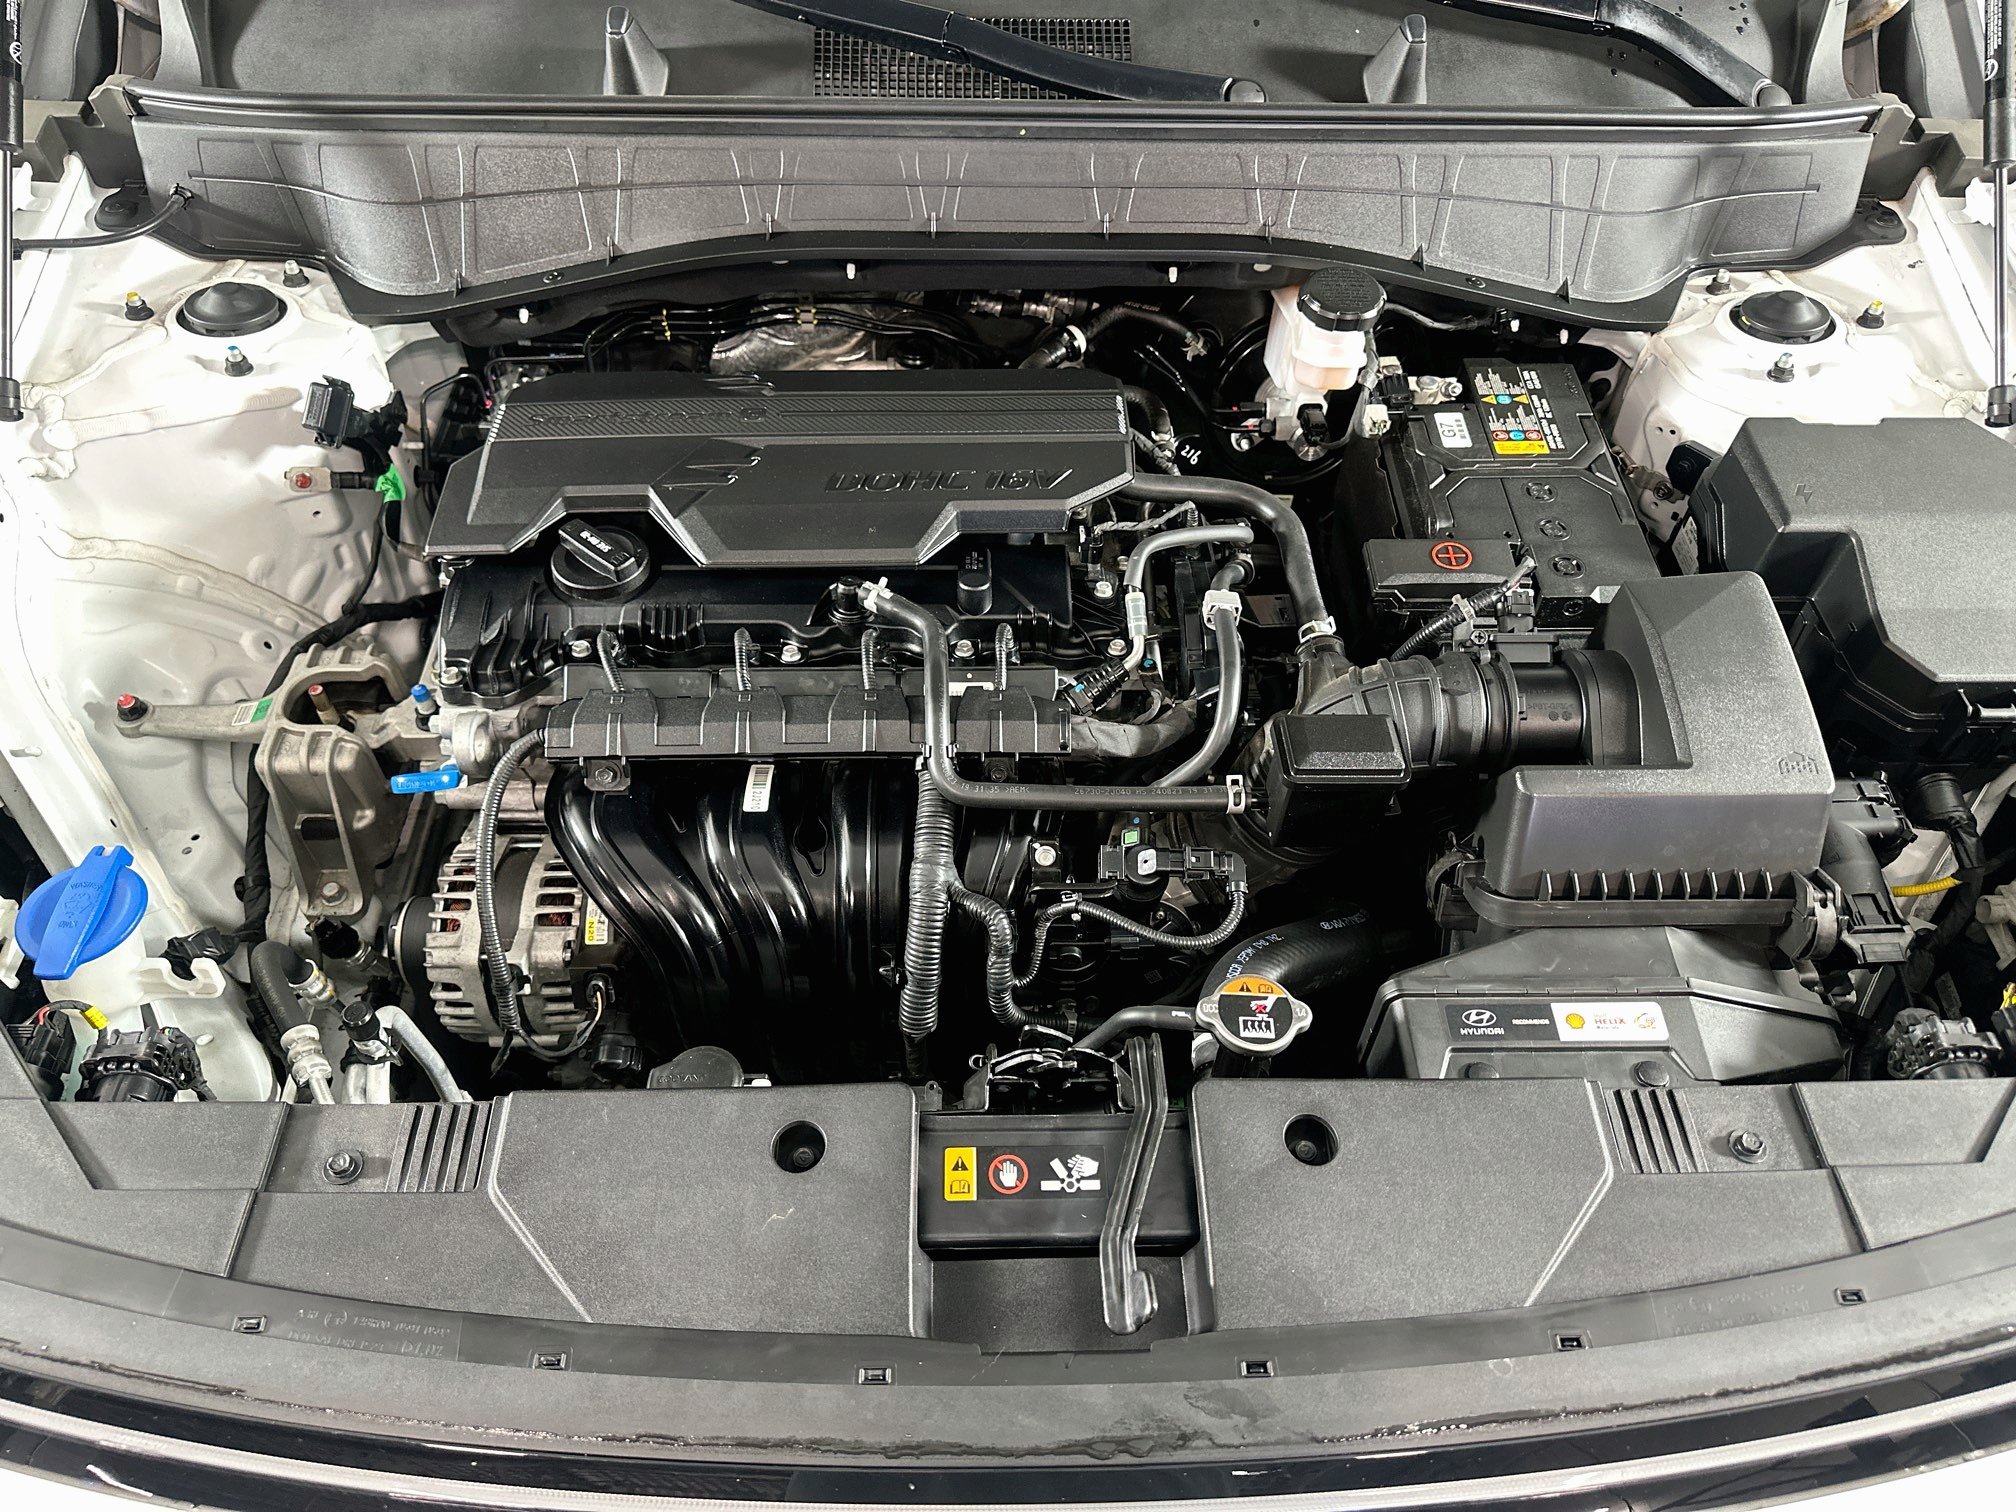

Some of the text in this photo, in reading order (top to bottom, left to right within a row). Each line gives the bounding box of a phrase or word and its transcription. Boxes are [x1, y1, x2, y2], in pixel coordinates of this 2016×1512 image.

[1181, 445, 1201, 465] 216
[826, 469, 1073, 492] DOHC 16V
[1460, 1027, 1505, 1036] HYUNDAI
